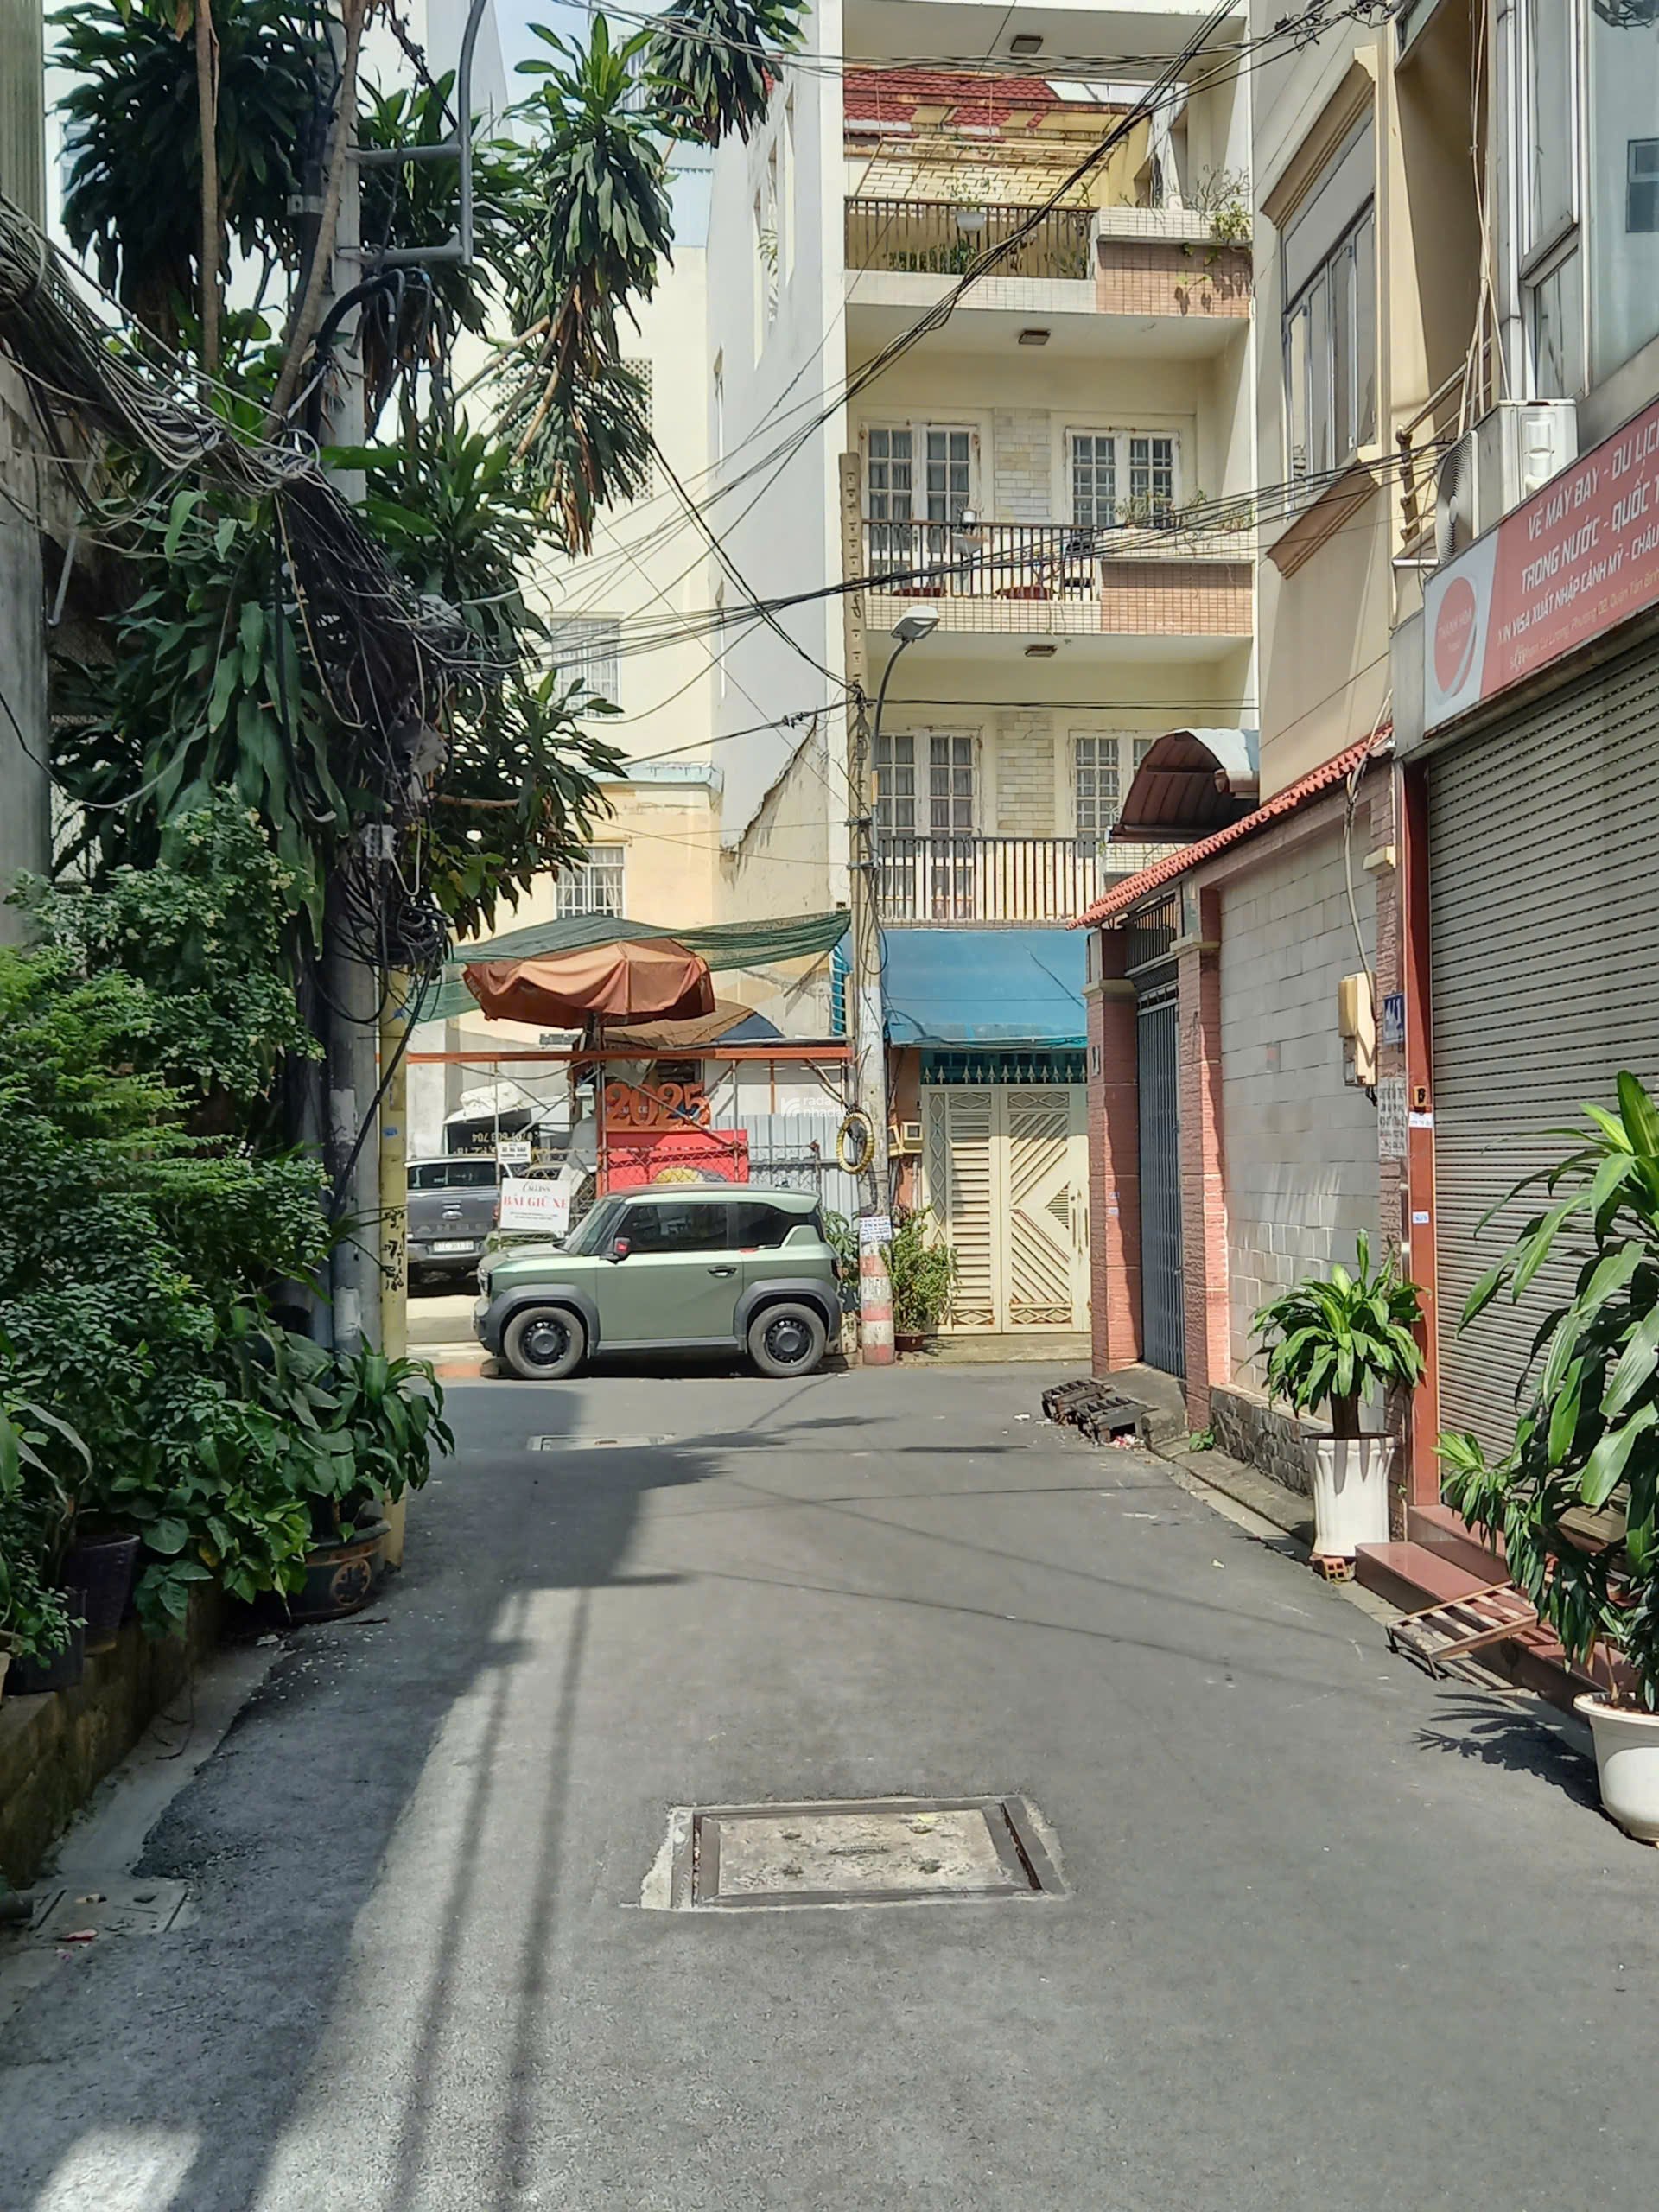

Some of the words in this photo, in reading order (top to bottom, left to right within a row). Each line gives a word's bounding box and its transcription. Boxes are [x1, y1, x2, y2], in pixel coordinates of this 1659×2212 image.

[1546, 485, 1572, 529] MÁY
[1574, 467, 1599, 508] BAY
[1612, 440, 1632, 480] DU
[1636, 418, 1659, 467] LỊC
[1522, 544, 1560, 594] TRONG
[1562, 516, 1600, 568] NƯỚC
[1611, 470, 1650, 532] QUỐC
[606, 1082, 711, 1126] 2025
